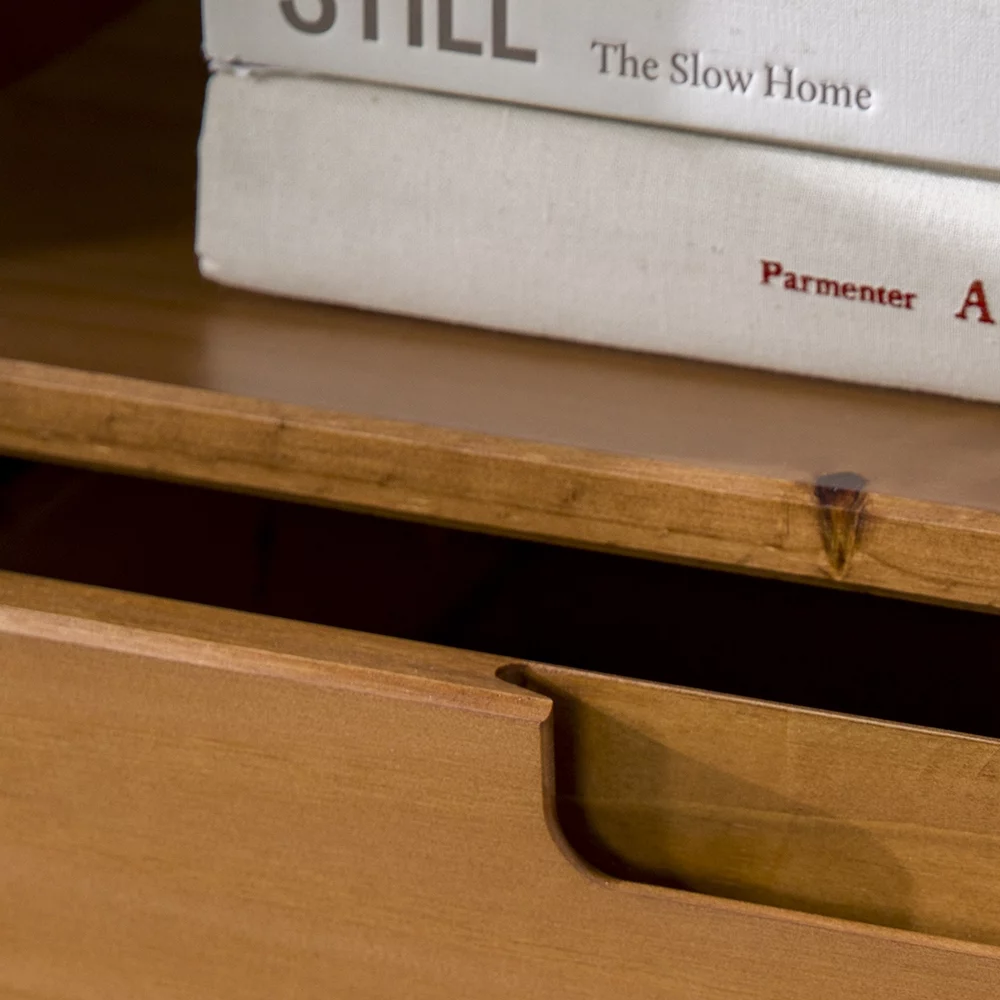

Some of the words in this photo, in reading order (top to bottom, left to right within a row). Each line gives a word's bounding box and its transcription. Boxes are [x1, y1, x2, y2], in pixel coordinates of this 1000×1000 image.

[590, 39, 660, 84] The
[669, 50, 754, 94] Slow
[763, 61, 873, 111] Home
[760, 260, 918, 311] Parmenter
[953, 279, 998, 326] A
